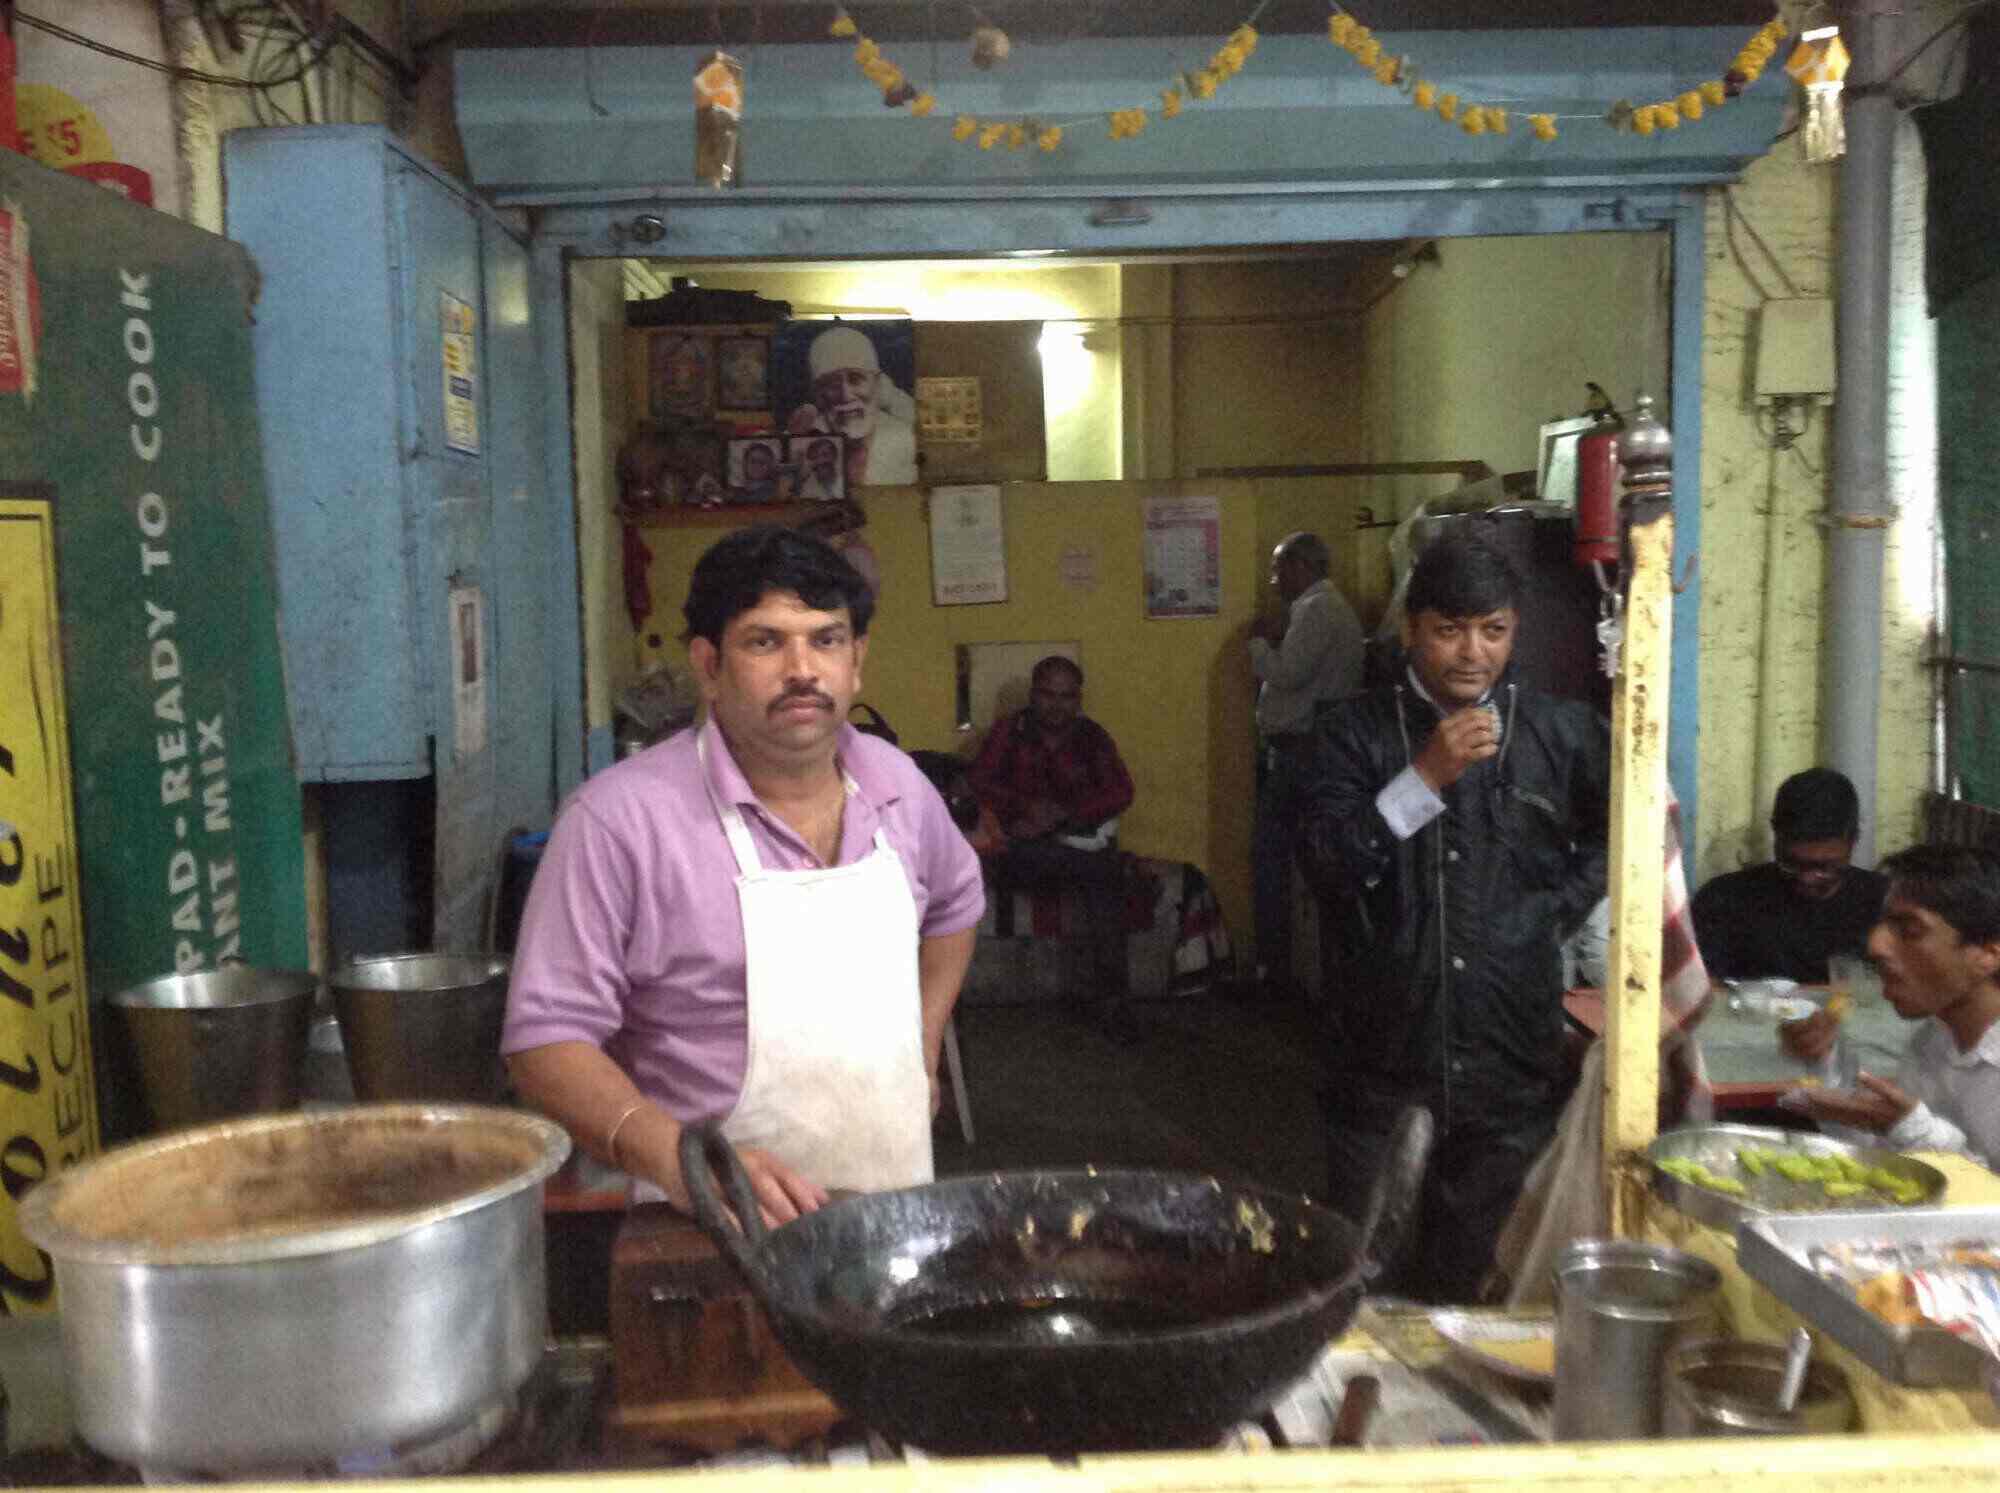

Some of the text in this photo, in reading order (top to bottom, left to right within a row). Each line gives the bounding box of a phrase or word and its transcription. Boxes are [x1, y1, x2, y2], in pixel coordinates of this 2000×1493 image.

[119, 268, 162, 462] COOK
[137, 492, 171, 576] TO
[197, 714, 232, 832] MIX
